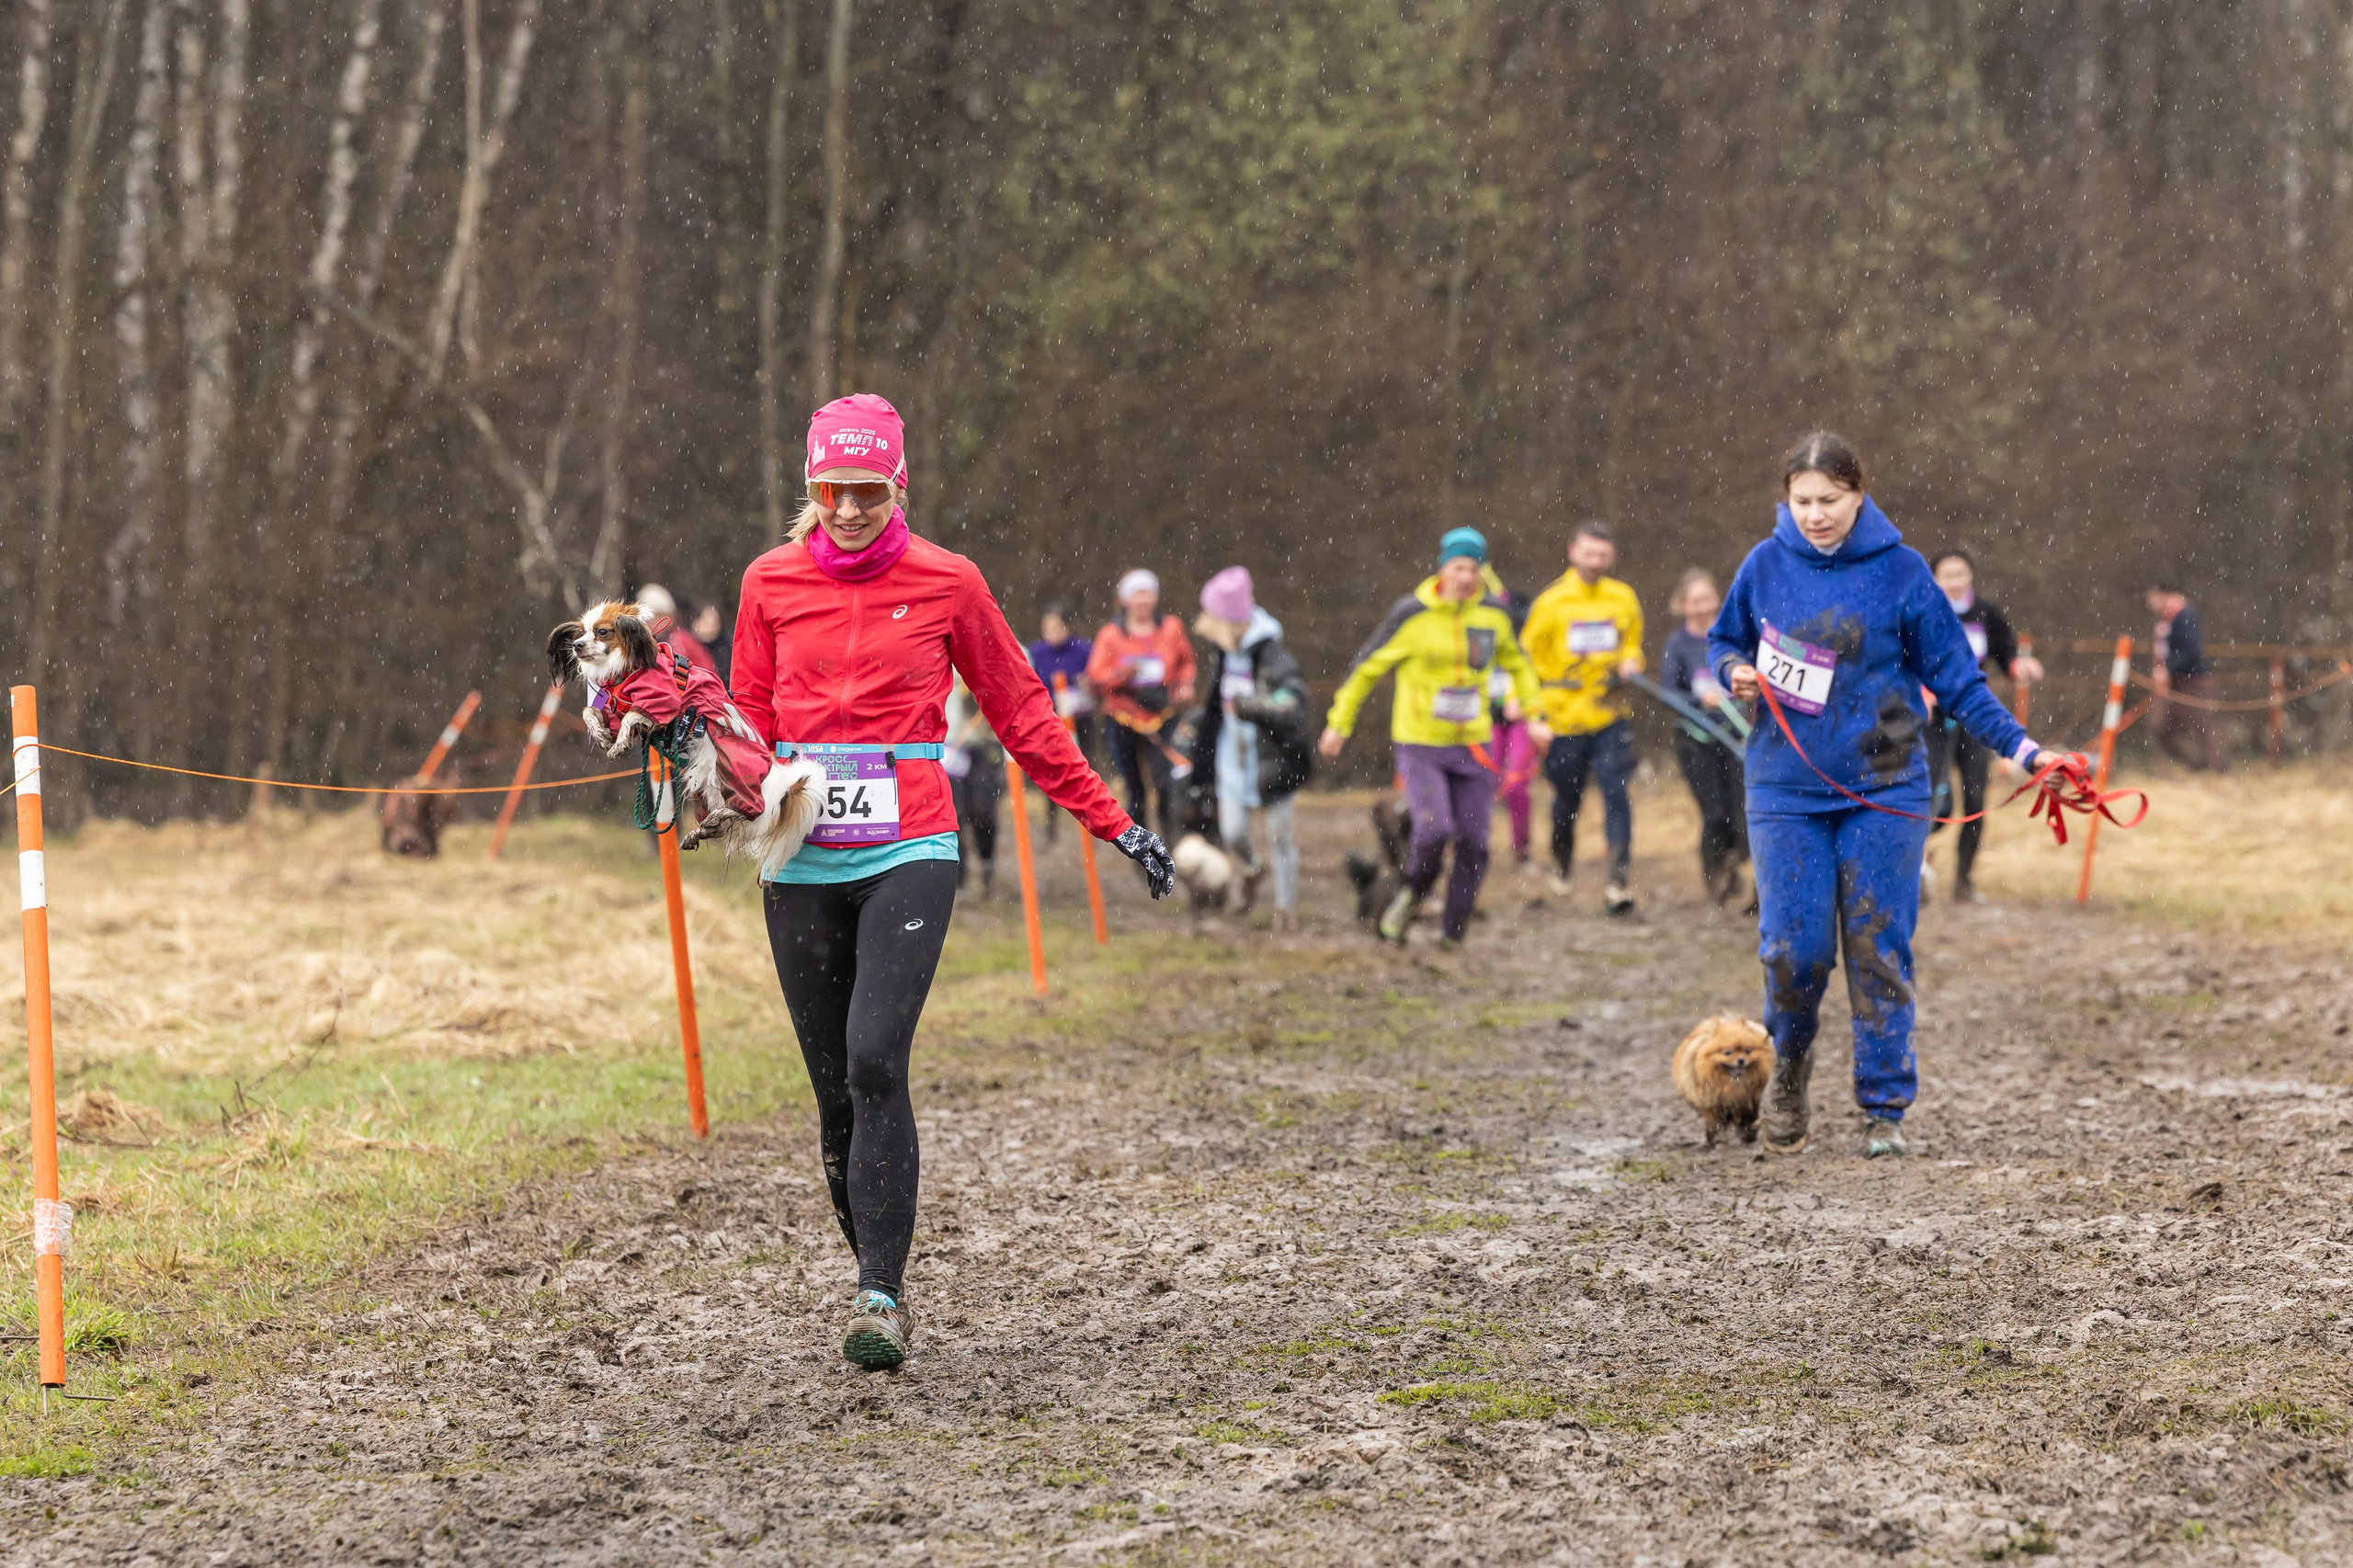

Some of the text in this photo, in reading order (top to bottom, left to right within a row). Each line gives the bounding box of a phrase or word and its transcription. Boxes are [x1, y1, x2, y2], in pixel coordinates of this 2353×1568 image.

[830, 433, 888, 450] ТЕМП 10
[844, 447, 870, 456] МГУ
[1768, 655, 1806, 692] 271
[819, 786, 871, 819] 54
